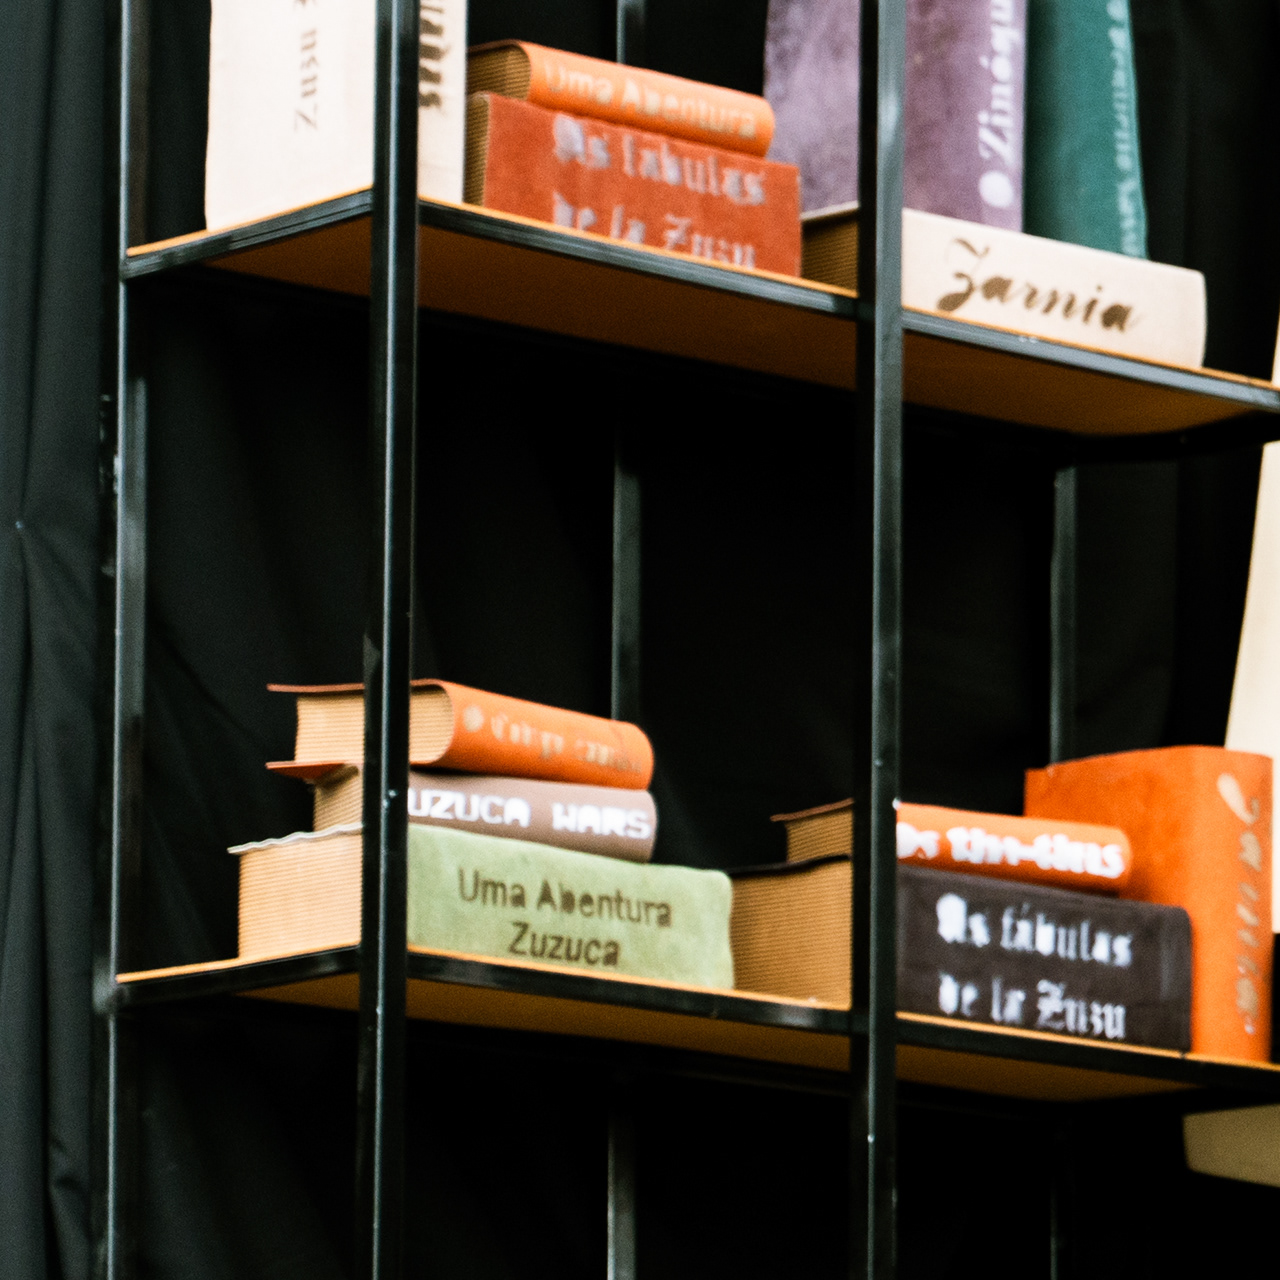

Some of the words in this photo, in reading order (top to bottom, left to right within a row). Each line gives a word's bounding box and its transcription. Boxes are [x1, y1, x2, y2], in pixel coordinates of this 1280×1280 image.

[543, 61, 615, 106] Uma
[406, 786, 532, 829] UZUCA
[551, 801, 653, 841] WARS
[457, 866, 528, 911] Uma
[534, 877, 675, 930] Abentura
[507, 921, 623, 968] Zuzuca
